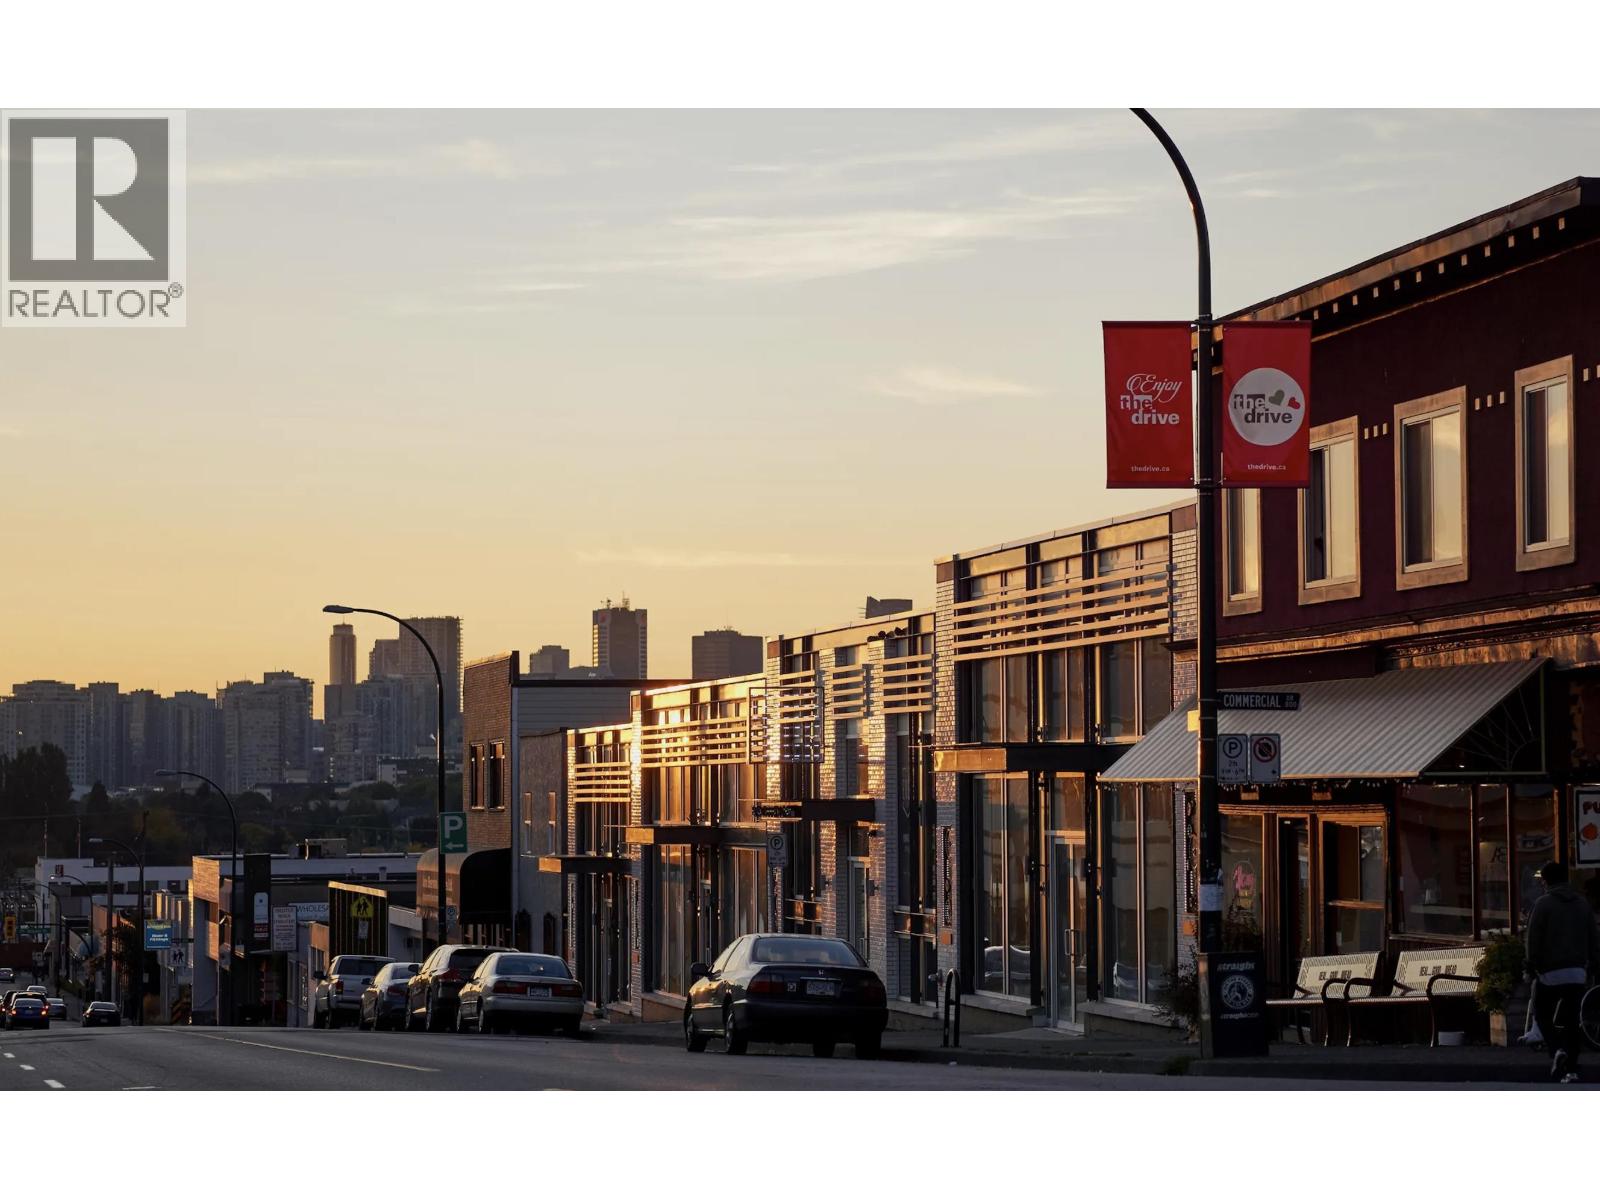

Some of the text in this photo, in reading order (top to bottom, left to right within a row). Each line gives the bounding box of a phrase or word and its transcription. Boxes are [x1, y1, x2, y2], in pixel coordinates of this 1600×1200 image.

[1126, 373, 1183, 403] Enjoy
[1120, 394, 1152, 410] the
[1234, 393, 1265, 410] the
[1131, 409, 1179, 425] drive
[1244, 409, 1293, 424] drive
[1247, 463, 1286, 471] thedrive.ca
[1223, 694, 1281, 708] COMMERCIAL
[1229, 742, 1238, 755] P
[444, 815, 463, 839] P
